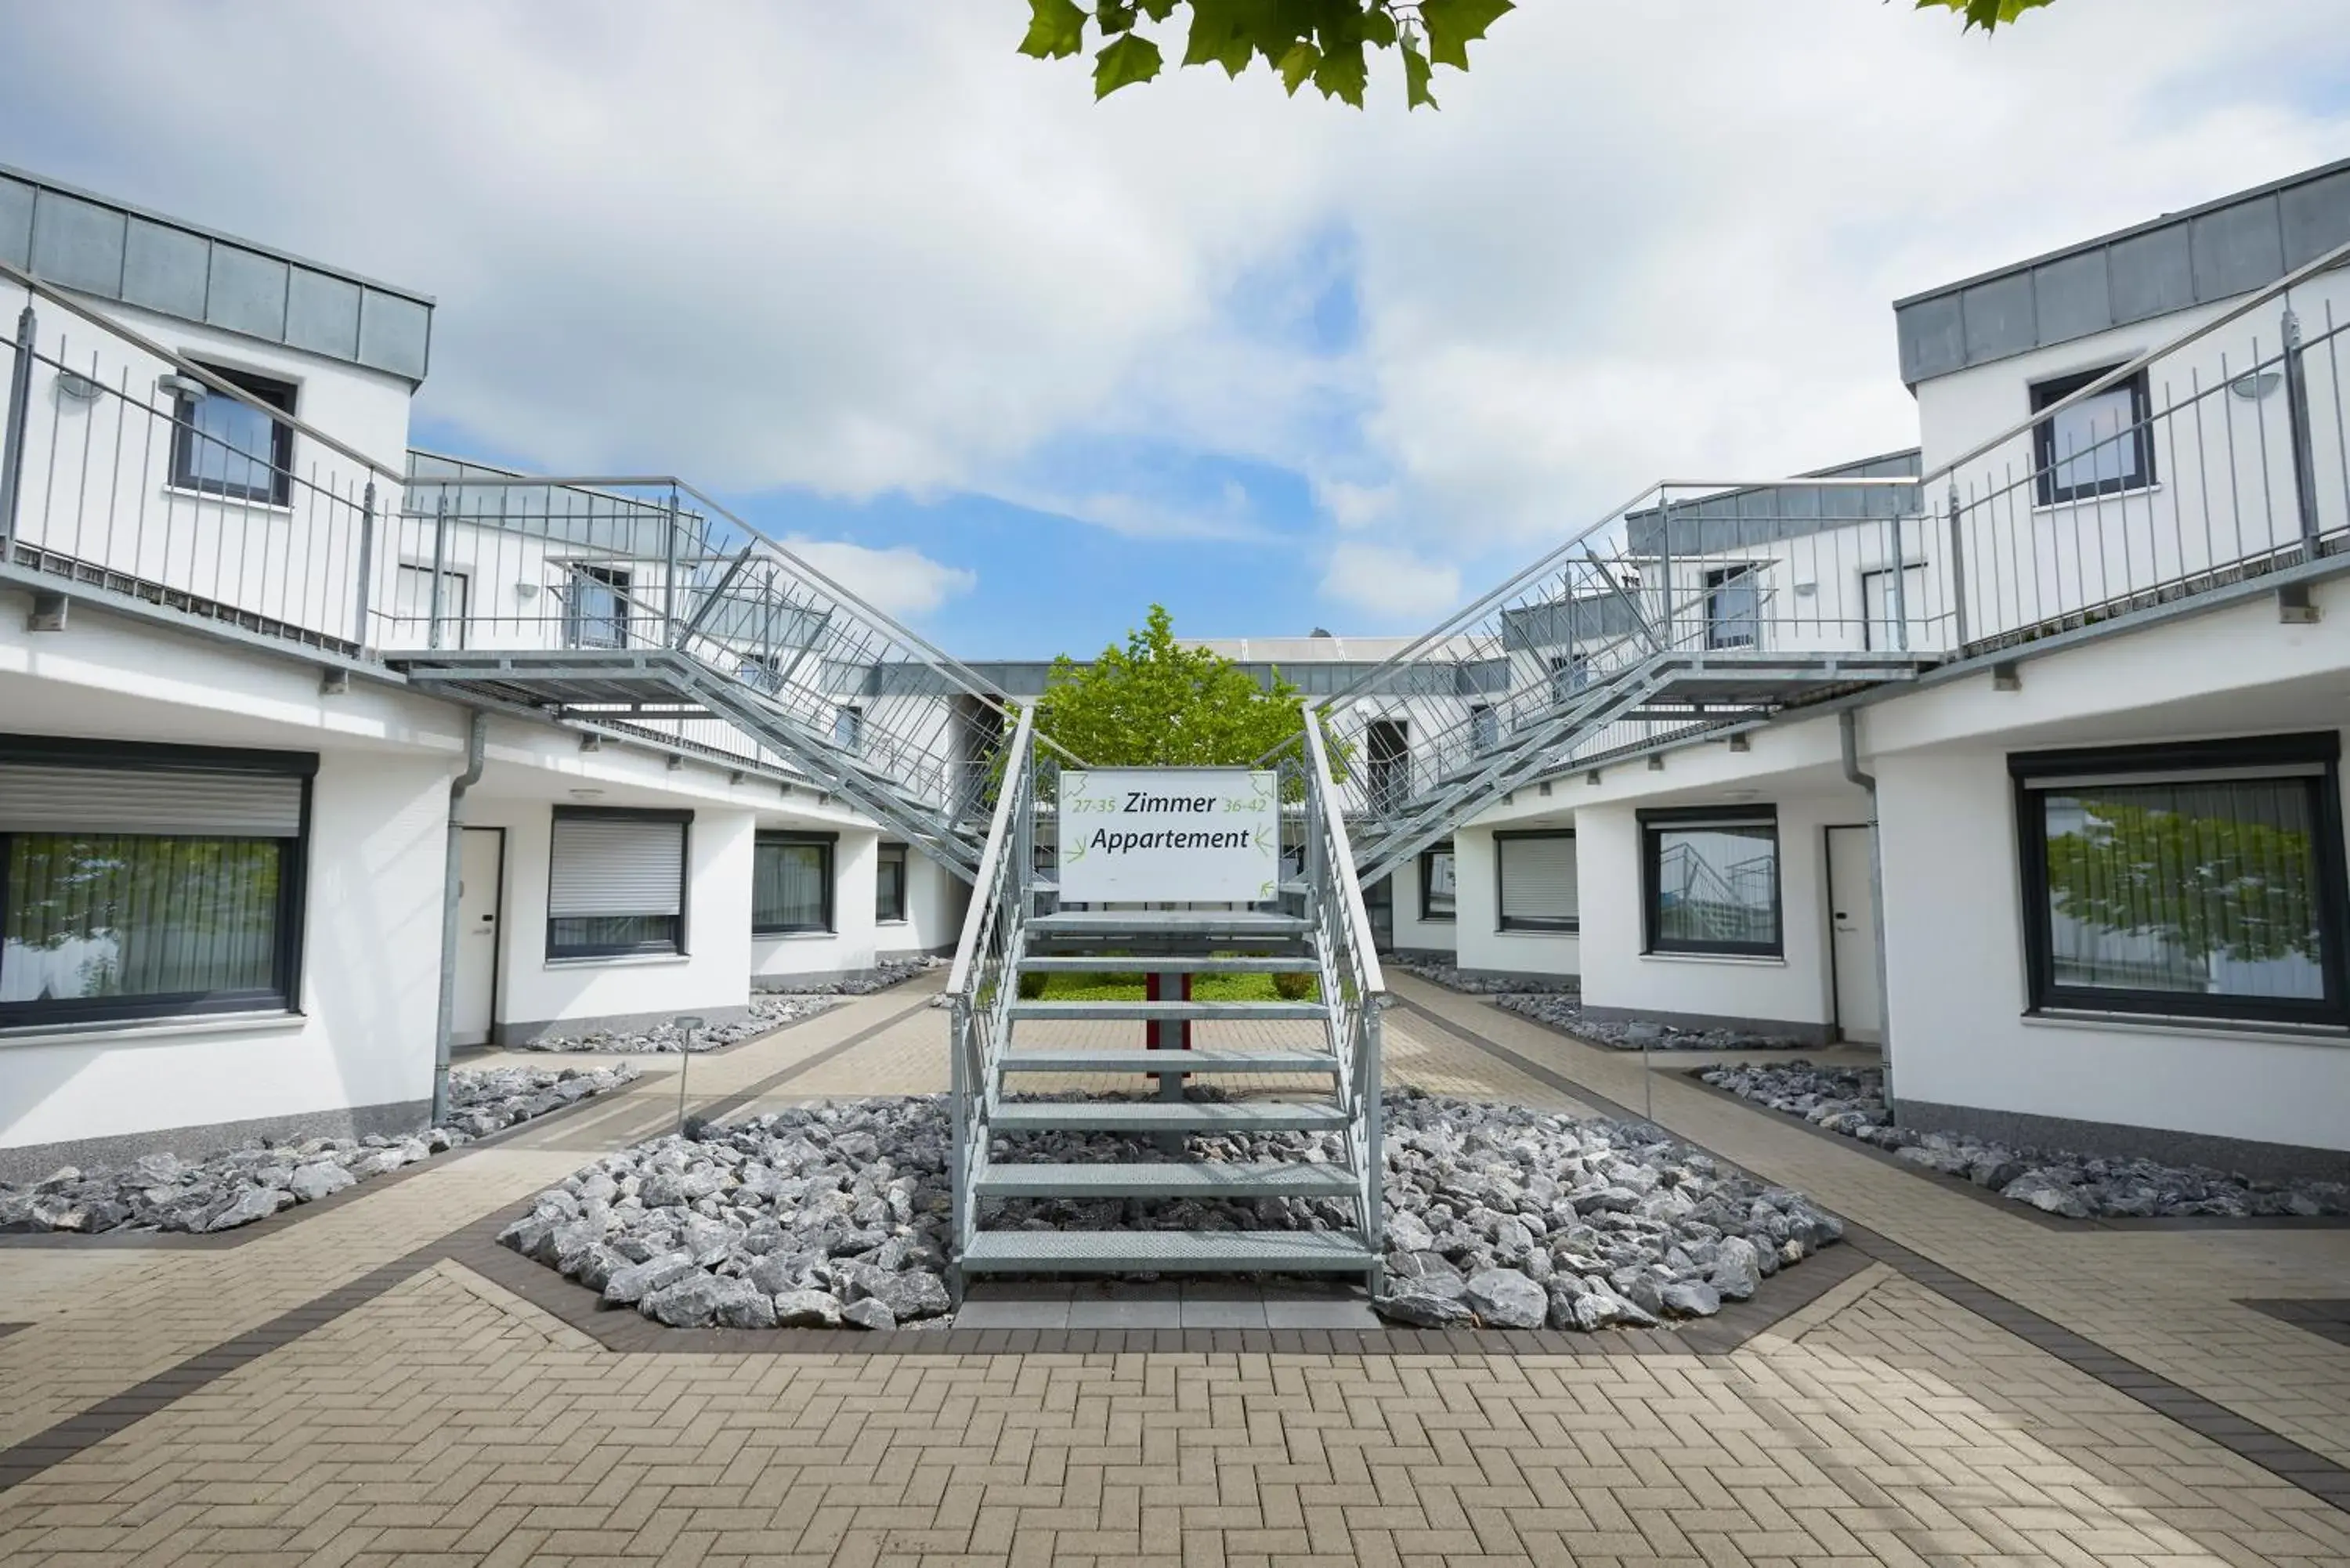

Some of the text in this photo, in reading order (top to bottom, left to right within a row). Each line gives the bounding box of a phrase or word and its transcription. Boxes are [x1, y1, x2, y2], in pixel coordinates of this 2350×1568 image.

[1072, 792, 1267, 813] 27-35 Zimmer 36-42
[1090, 828, 1249, 854] Appartement
